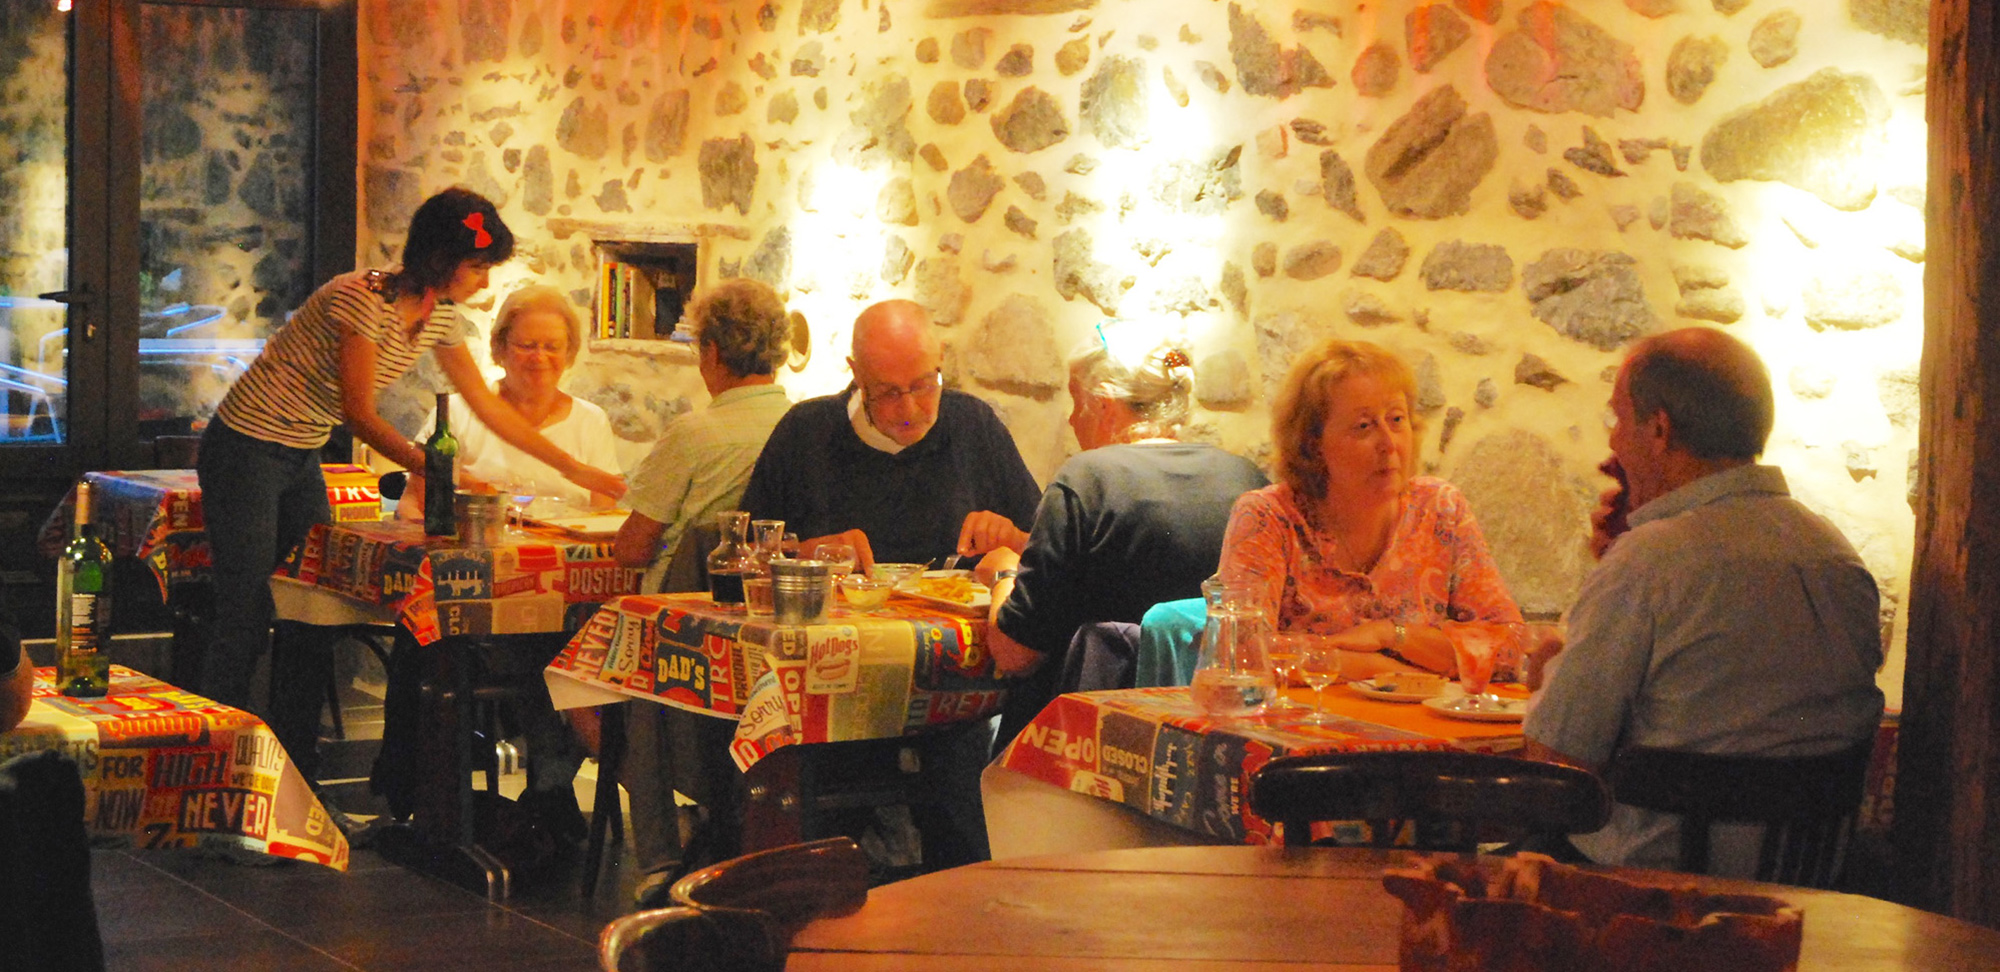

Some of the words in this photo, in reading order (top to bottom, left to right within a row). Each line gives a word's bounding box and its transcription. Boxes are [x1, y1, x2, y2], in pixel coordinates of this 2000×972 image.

[658, 655, 705, 690] DAD'S
[1022, 722, 1095, 763] OPEN
[1102, 745, 1147, 774] CLOSED
[102, 753, 144, 778] FOR
[151, 752, 228, 788] HIGH
[184, 792, 268, 836] NEVER
